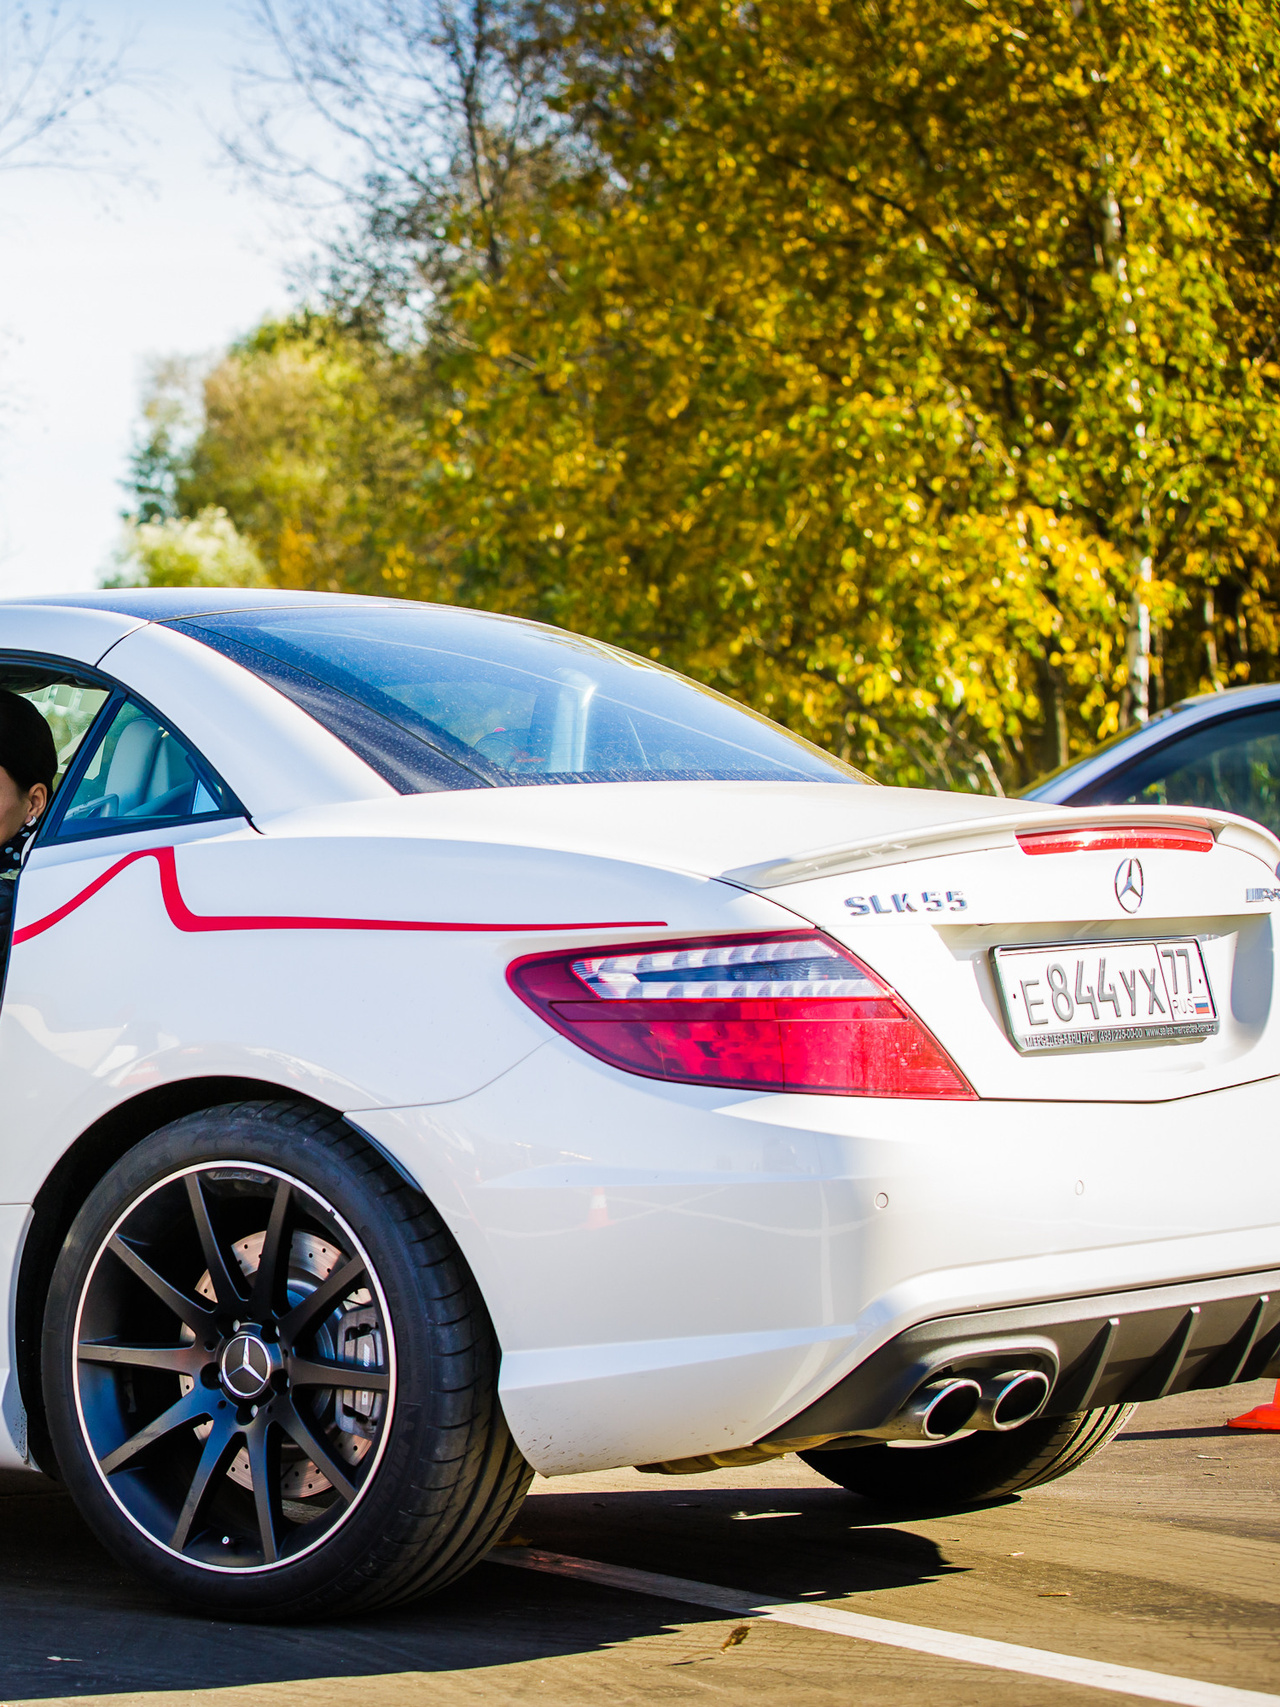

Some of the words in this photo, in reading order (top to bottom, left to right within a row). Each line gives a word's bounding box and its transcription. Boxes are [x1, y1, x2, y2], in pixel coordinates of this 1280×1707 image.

[844, 893, 918, 916] SLK
[921, 890, 968, 912] 55
[1160, 948, 1193, 995] 77
[1172, 997, 1195, 1014] RUS
